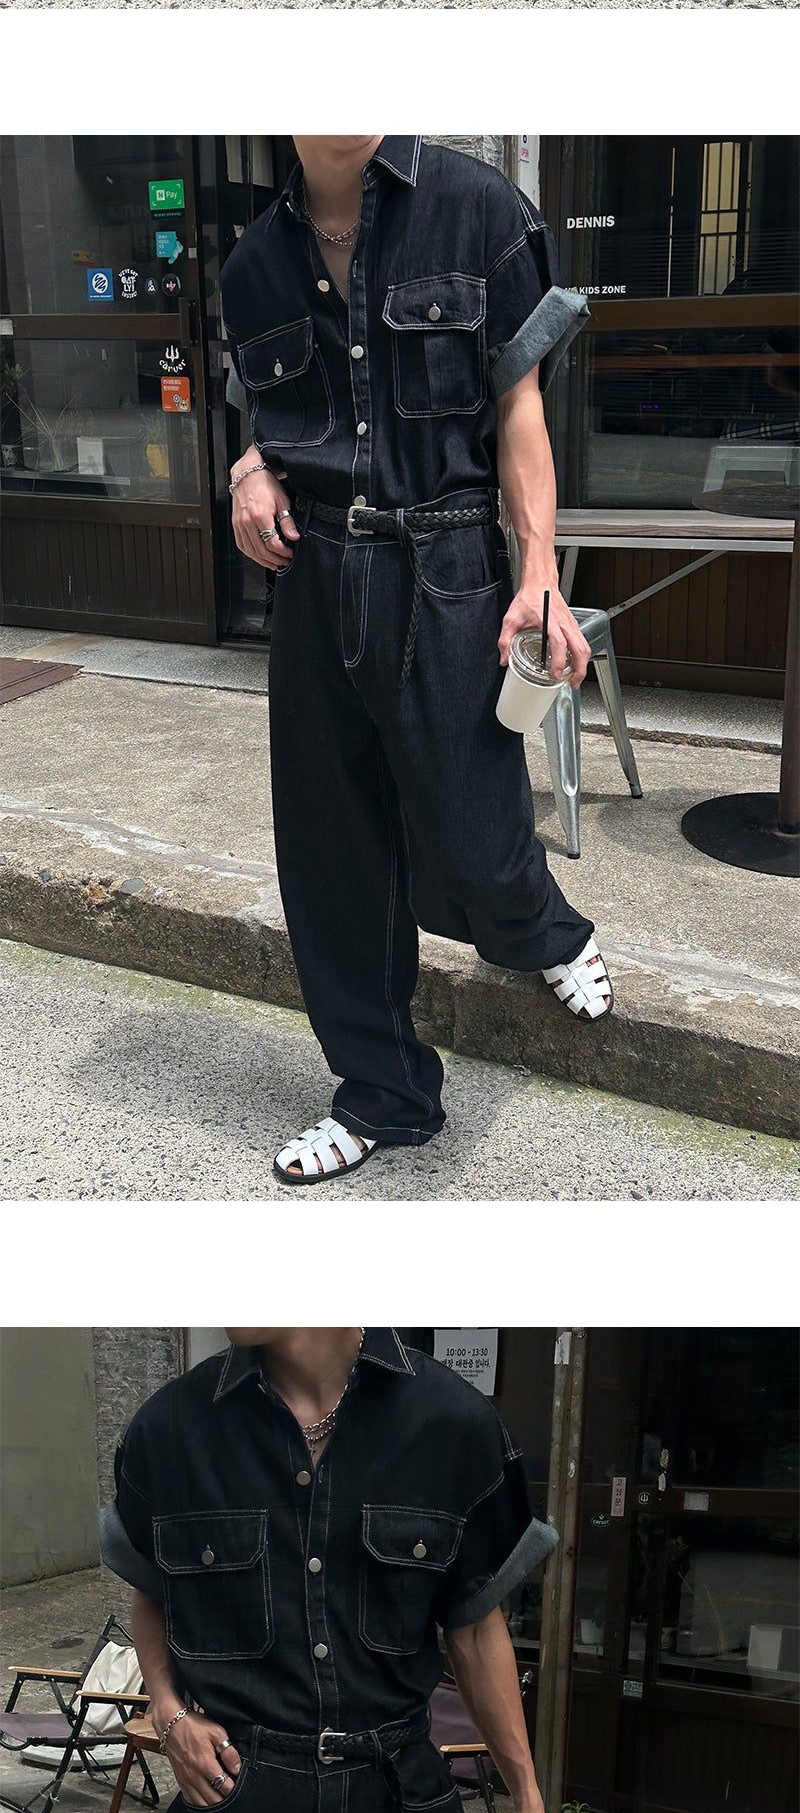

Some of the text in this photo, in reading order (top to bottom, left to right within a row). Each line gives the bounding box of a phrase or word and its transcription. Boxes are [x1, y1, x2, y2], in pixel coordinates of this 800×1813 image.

[166, 191, 177, 199] Pay
[566, 216, 616, 229] DENNIS
[579, 287, 600, 295] KIDS
[602, 286, 626, 294] ZONE
[446, 1348, 489, 1357] 10:00 13:30
